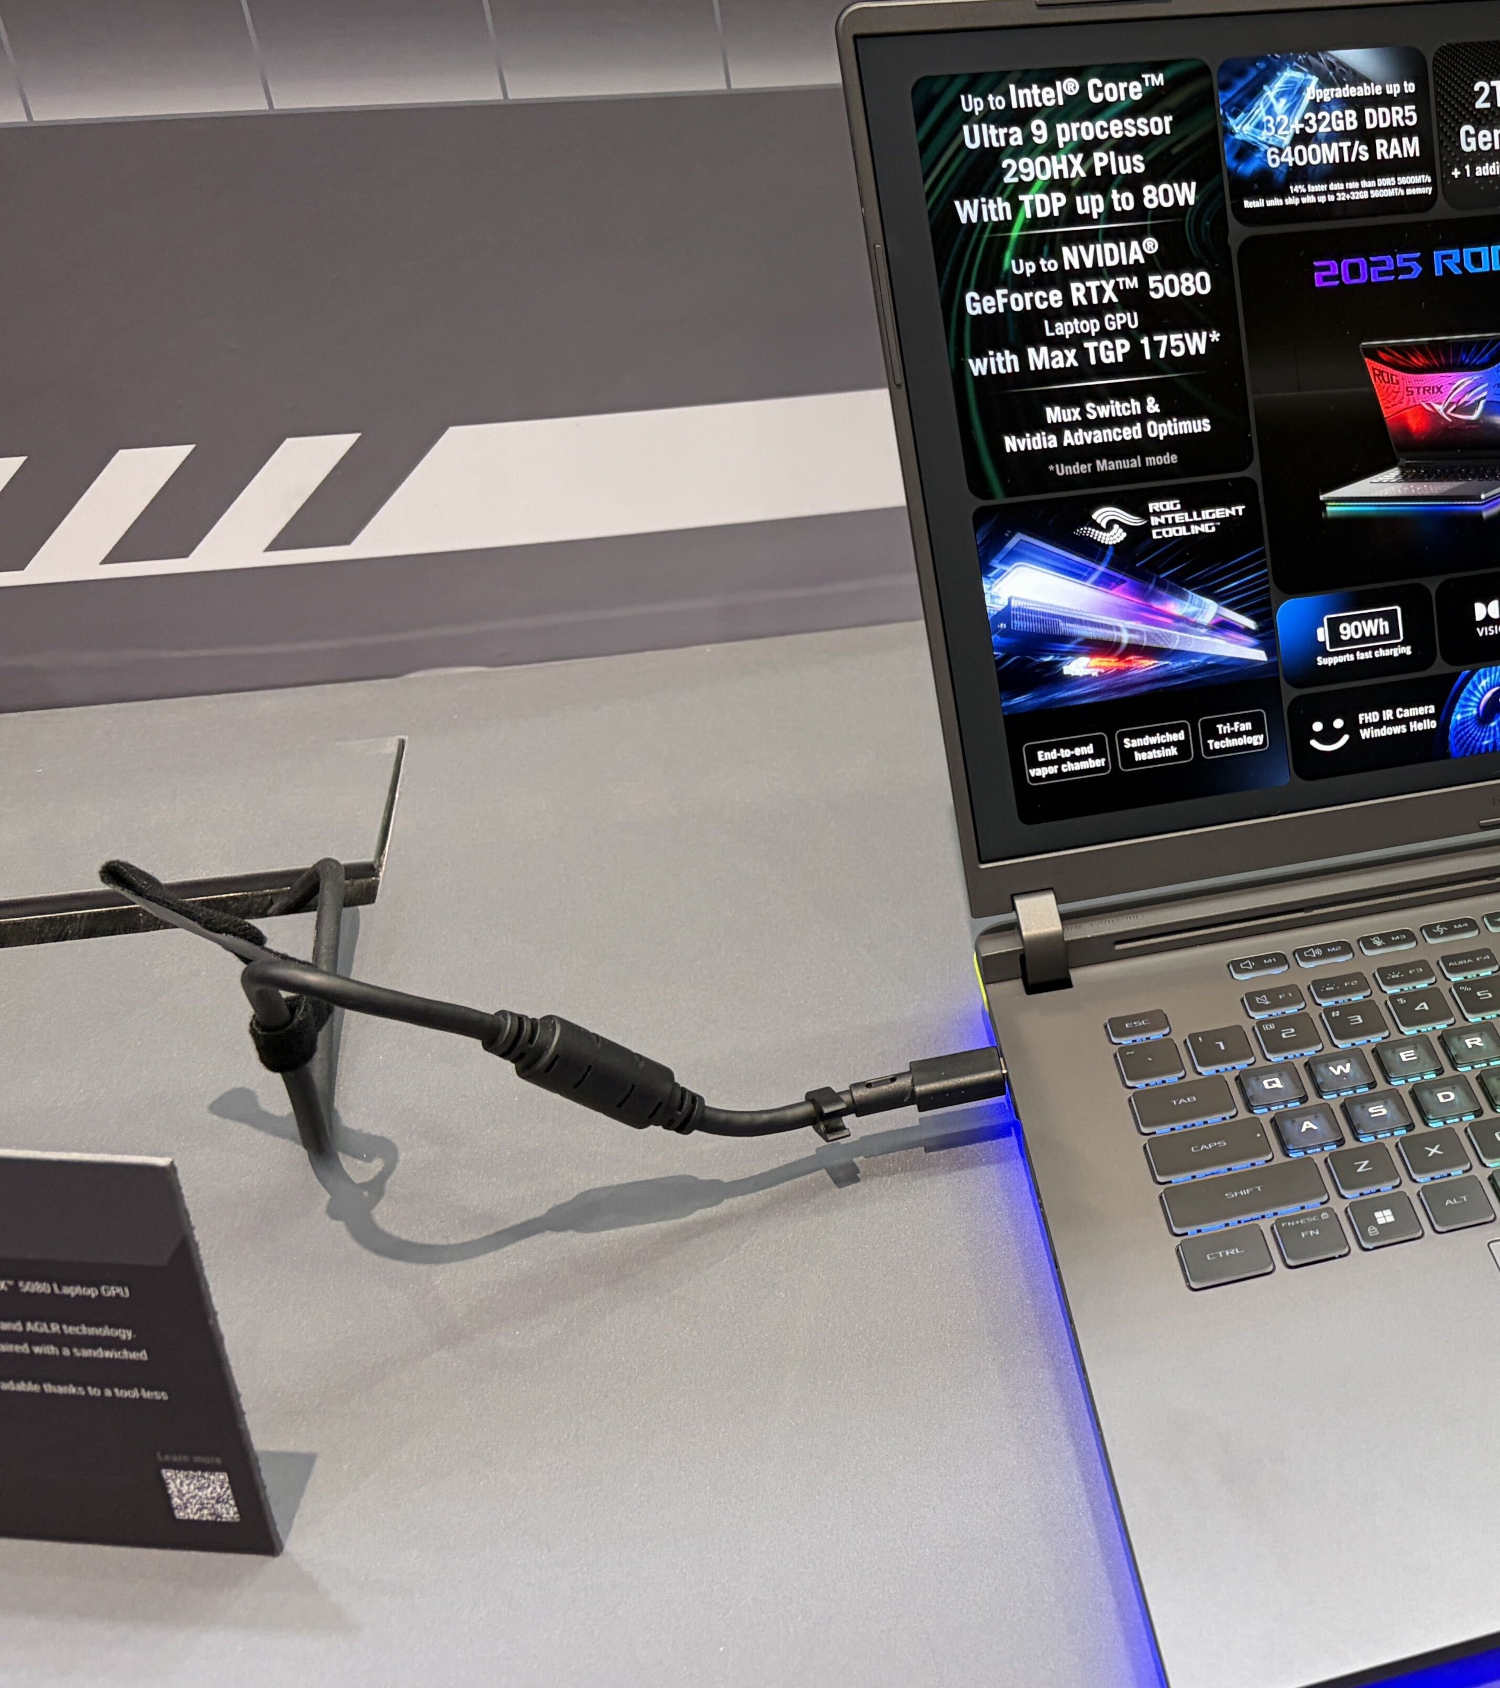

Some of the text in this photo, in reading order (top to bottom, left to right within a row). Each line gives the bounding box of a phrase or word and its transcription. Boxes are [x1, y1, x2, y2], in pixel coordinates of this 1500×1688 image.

[961, 74, 1164, 116] Up to Intel® Core™
[1307, 80, 1415, 102] Upgradeable up to
[1262, 106, 1417, 136] 32+32GB DDR5
[963, 114, 1173, 150] Ultra 9 processor
[1267, 136, 1420, 168] 6400MT/s RAM
[1002, 151, 1145, 184] 290HX Plus
[1465, 164, 1471, 177] 1
[954, 181, 1197, 224] With TDP up to 80W
[1011, 237, 1159, 277] Up to NVIDIA®
[1313, 252, 1422, 288] 2025
[966, 271, 1212, 316] GeForce RTX™ 5080
[1044, 312, 1138, 339] Laptop GPU
[969, 351, 1019, 376] with
[1027, 347, 1078, 371] Max
[1084, 339, 1130, 365] TGP
[1046, 397, 1160, 423] Mux Switch &
[1004, 417, 1211, 453] Nvidia Advanced Optimus
[1148, 500, 1181, 512] ROG
[1150, 506, 1245, 526] INTELLIGENT
[1339, 618, 1389, 641] 90Wh
[1317, 645, 1412, 667] Supports fast charging
[1358, 704, 1435, 725] FHD IR Camera
[1216, 721, 1252, 735] Tri-Fan
[1359, 718, 1437, 740] Windows Hello
[1123, 730, 1185, 749] Sandwiched
[1207, 732, 1264, 750] Technology
[1037, 743, 1094, 762] End-to-end
[1134, 746, 1178, 762] heatsink
[1029, 757, 1106, 778] vapor chamber
[1125, 1019, 1150, 1028] ESC
[1329, 1063, 1351, 1076] W
[1171, 1096, 1197, 1106] TAB
[1436, 1091, 1455, 1103] D
[1368, 1104, 1387, 1118] S
[1301, 1120, 1319, 1133] A
[1191, 1140, 1227, 1153] CAPS
[1225, 1185, 1264, 1199] SHIFT
[1206, 1247, 1244, 1261] CTRL
[53, 1282, 130, 1299] Laptop GPU
[26, 1322, 136, 1340] AGLR technology.
